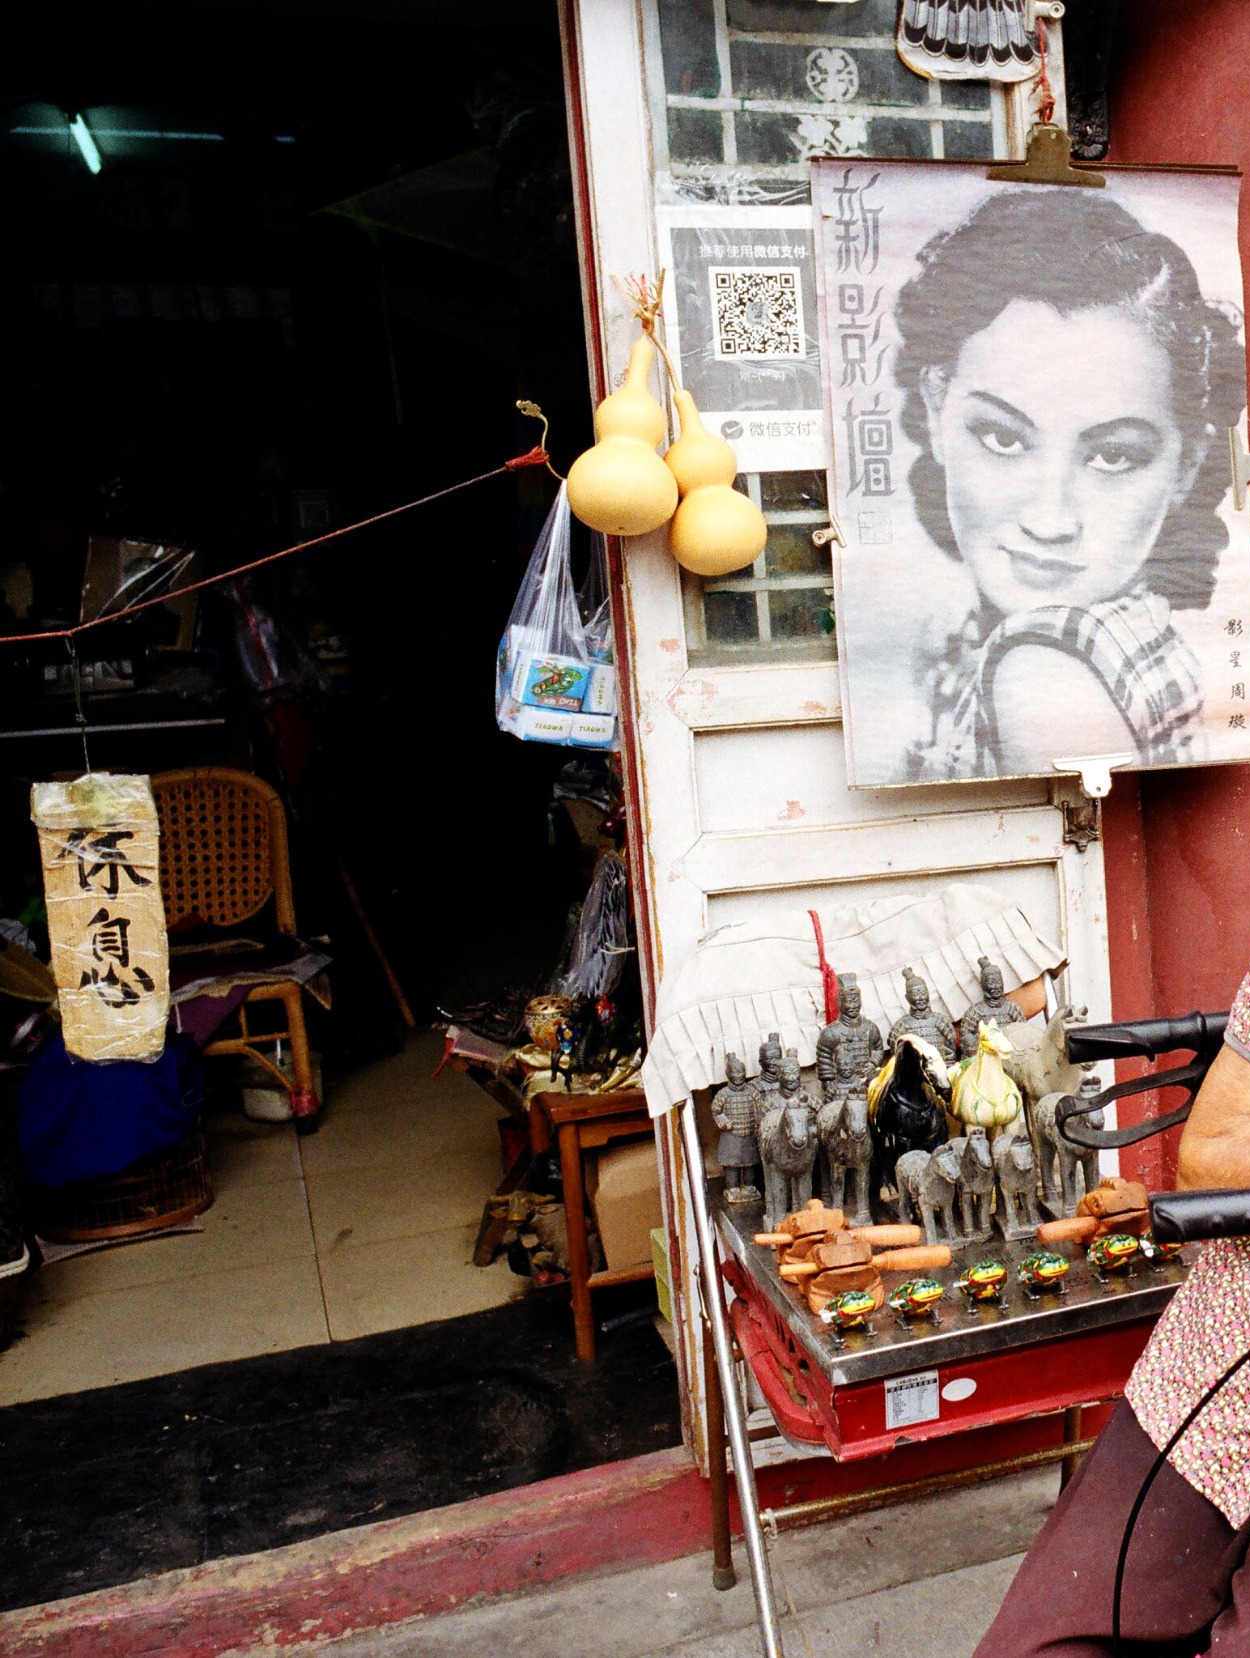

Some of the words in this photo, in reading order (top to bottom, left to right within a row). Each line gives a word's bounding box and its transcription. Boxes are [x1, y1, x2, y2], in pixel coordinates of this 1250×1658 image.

[698, 244, 806, 259] 推荐使用微信支付
[832, 168, 896, 497] 新影壇
[750, 420, 812, 437] 微信支付
[1223, 619, 1247, 729] 影星周璇
